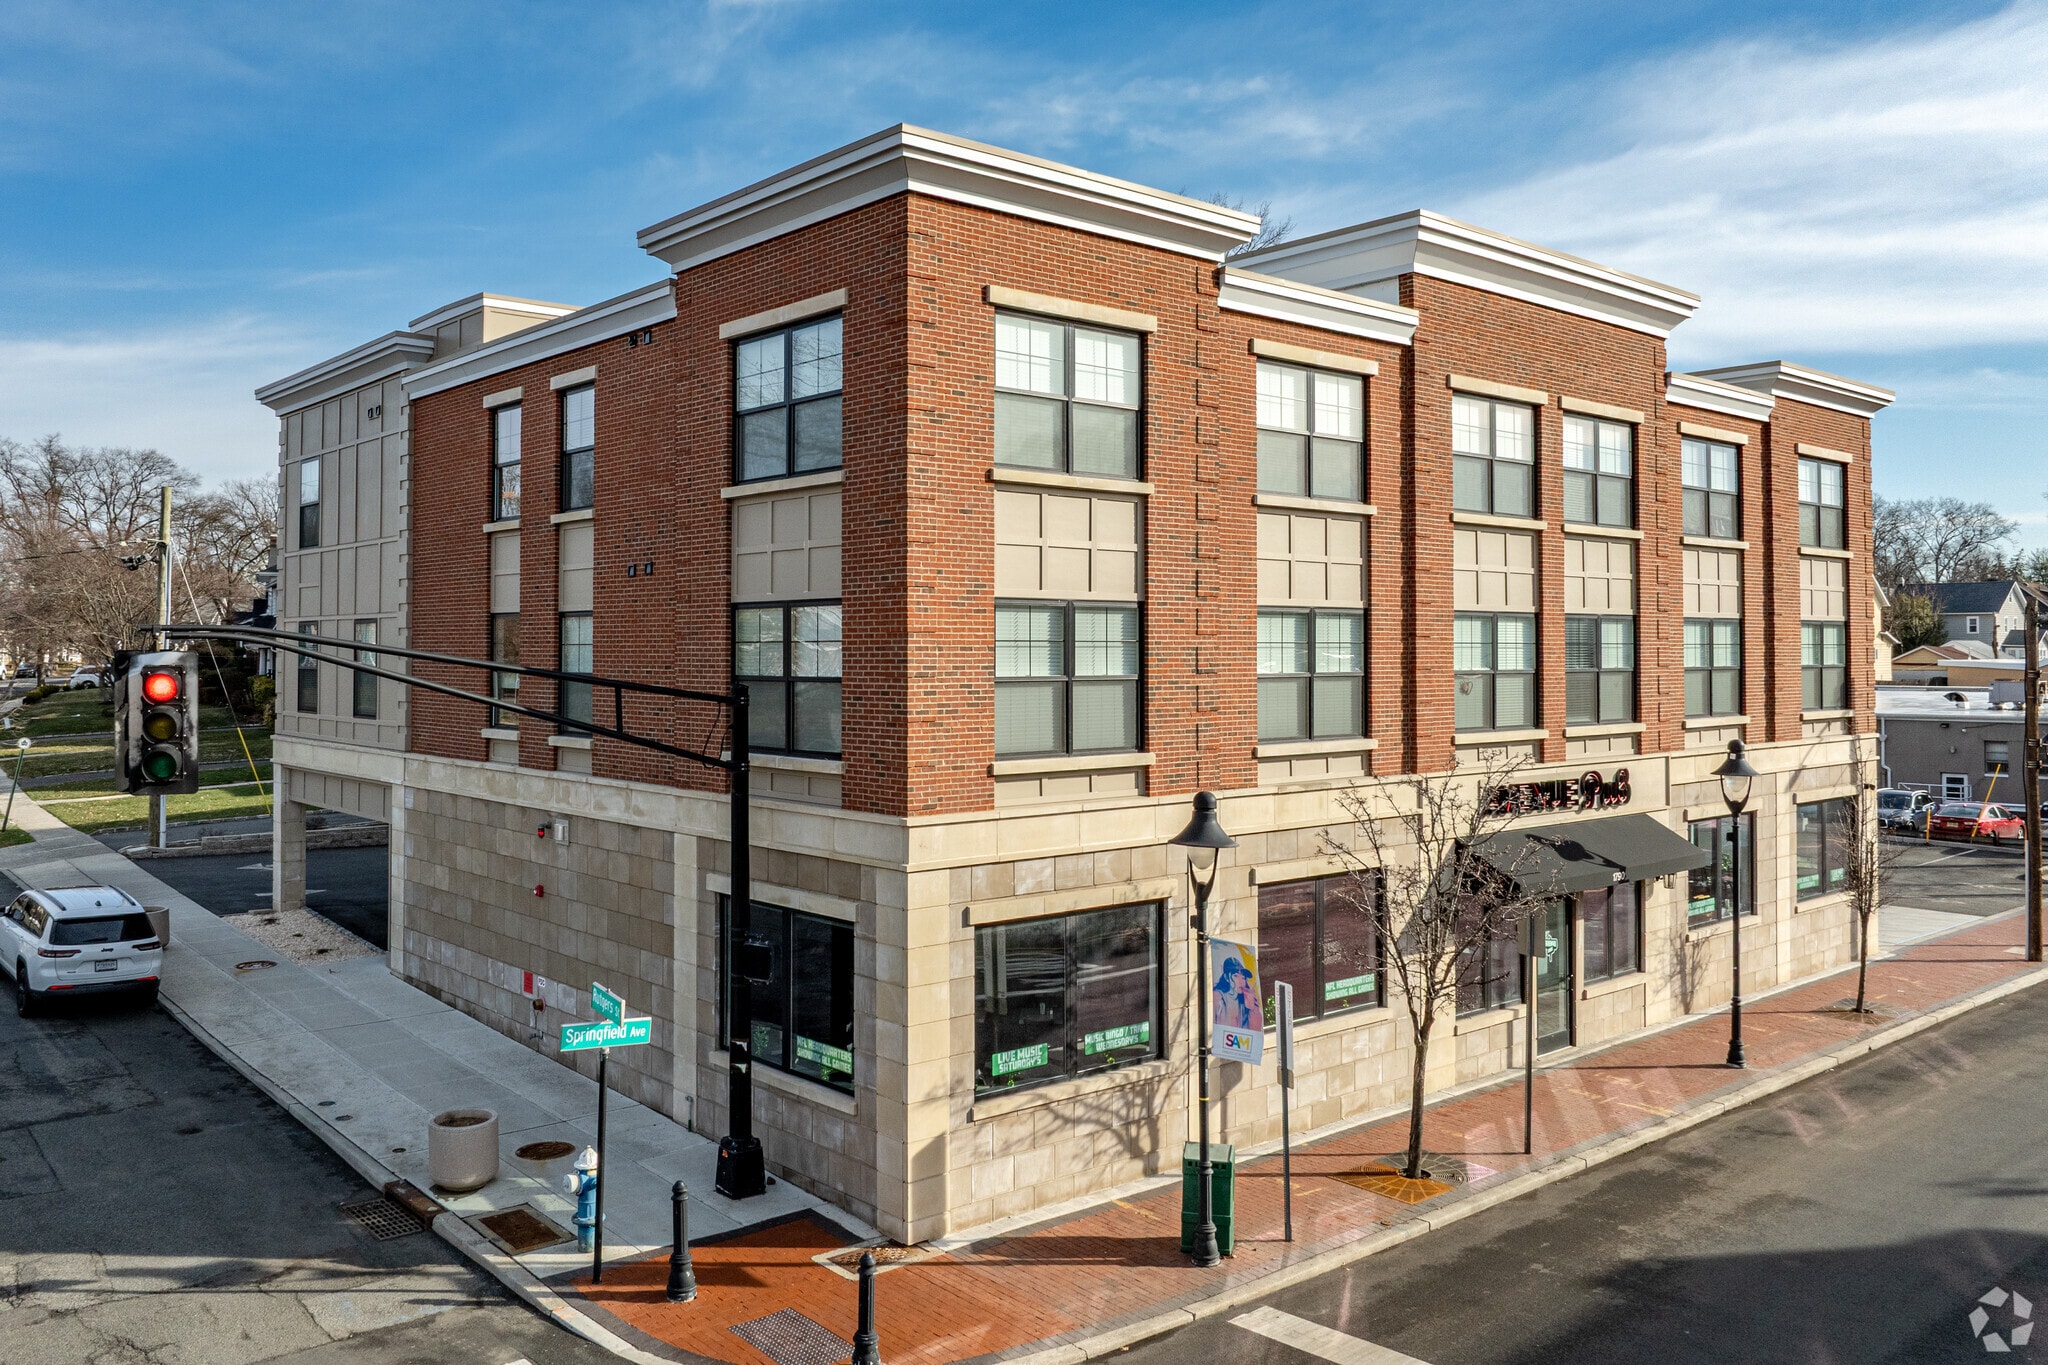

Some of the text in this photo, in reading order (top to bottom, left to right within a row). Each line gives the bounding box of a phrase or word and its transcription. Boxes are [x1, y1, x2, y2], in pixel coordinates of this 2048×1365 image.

[1612, 871, 1626, 882] 1790
[593, 987, 620, 1018] Rutgers St
[565, 1025, 646, 1047] Springfield Ave
[797, 1034, 808, 1048] NFL
[1085, 1032, 1105, 1045] MUSIC
[1105, 1028, 1124, 1040] BINGO
[1096, 1034, 1139, 1052] WEDNESDAY'S
[1225, 1033, 1250, 1050] SAM
[998, 1044, 1042, 1064] LIVE MUSIC
[821, 1055, 832, 1068] ALL
[832, 1059, 852, 1075] GAMES
[999, 1055, 1041, 1073] SATURDAY'S
